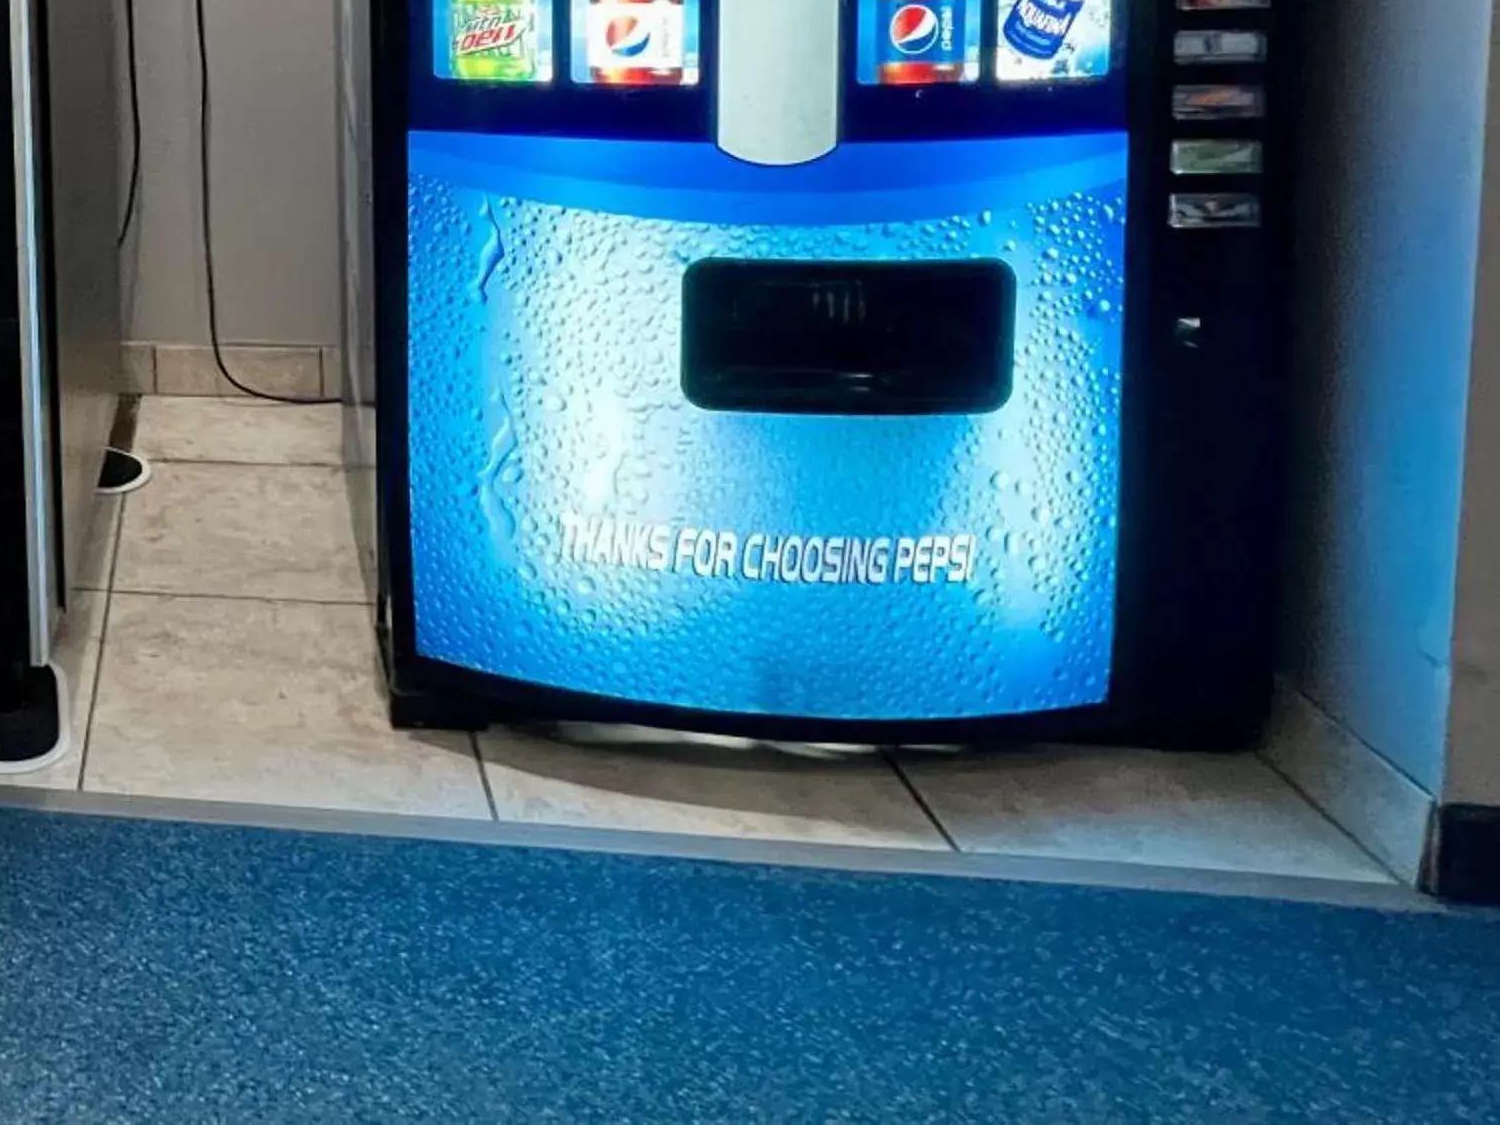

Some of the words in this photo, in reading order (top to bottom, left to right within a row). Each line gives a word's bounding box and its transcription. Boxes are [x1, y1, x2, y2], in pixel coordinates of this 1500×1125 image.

[939, 4, 954, 51] pepsi
[558, 509, 670, 573] THANKS
[672, 525, 736, 579] FOR
[742, 533, 891, 585] CHOOSING
[893, 533, 979, 586] PEPSI
